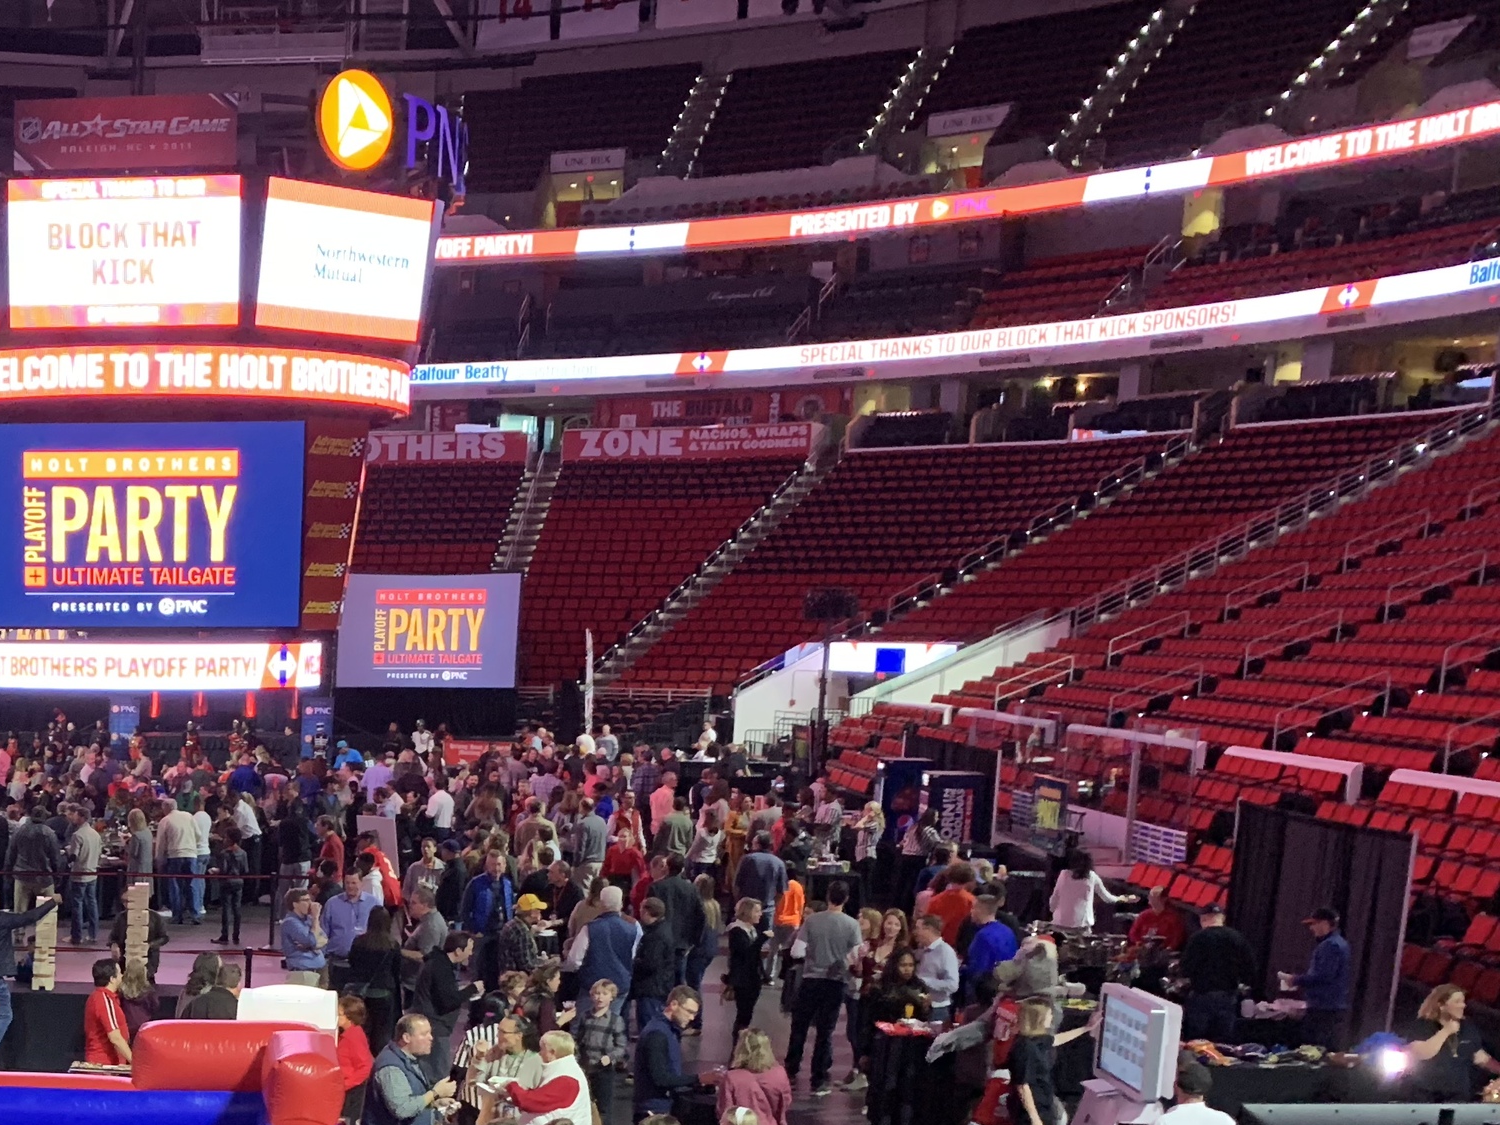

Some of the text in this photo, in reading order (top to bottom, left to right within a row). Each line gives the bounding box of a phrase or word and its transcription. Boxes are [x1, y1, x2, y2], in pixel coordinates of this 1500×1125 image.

[104, 118, 166, 138] STAR
[168, 116, 231, 136] GAME
[126, 143, 142, 151] NC
[163, 142, 192, 150] 2011
[1246, 134, 1342, 176] WELCOME
[1346, 129, 1373, 158] TO
[1376, 120, 1417, 150] THE
[1419, 109, 1470, 145] HOLT
[790, 195, 996, 237] PRESENTED BY PNC
[47, 220, 202, 250] BLOCK THAT
[474, 234, 534, 256] PARTY!
[315, 243, 410, 269] Northwestern
[91, 258, 155, 285] KICK
[313, 262, 363, 284] Mutual
[800, 304, 1237, 364] SPECIAL THANKS TO OUR BLOCK THAT KICK SPONSORS!
[109, 352, 149, 388] TO
[154, 352, 212, 388] THE
[218, 353, 287, 391] HOLT
[291, 356, 390, 399] BROTHERS
[409, 364, 509, 381] Balfour Beatty
[651, 400, 683, 418] THE
[579, 429, 684, 457] ZONE
[755, 425, 808, 439] WRAPS
[701, 440, 740, 451] TASTY
[742, 437, 807, 450] GOODNESS
[30, 456, 233, 472] HOLT BROTHERS
[23, 485, 46, 563] PLAYOFF
[51, 484, 238, 563] PARTY
[52, 566, 236, 586] ULTIMATE TAILGATE
[51, 600, 208, 613] PRESENTED BY PNC
[379, 592, 483, 601] HOLT BROTHERS
[373, 608, 387, 652] PLAYOFF
[387, 607, 486, 652] PARTY
[10, 655, 98, 678] BROTHERS
[104, 656, 188, 678] PLAYOFF
[194, 656, 258, 678] PARTY!
[387, 653, 483, 664] ULTIMATE TAILGATE
[451, 671, 468, 680] PNC
[120, 705, 137, 714] PNC
[313, 706, 331, 715] PNC
[940, 805, 957, 840] ORN
[954, 788, 966, 843] AROLINAS
